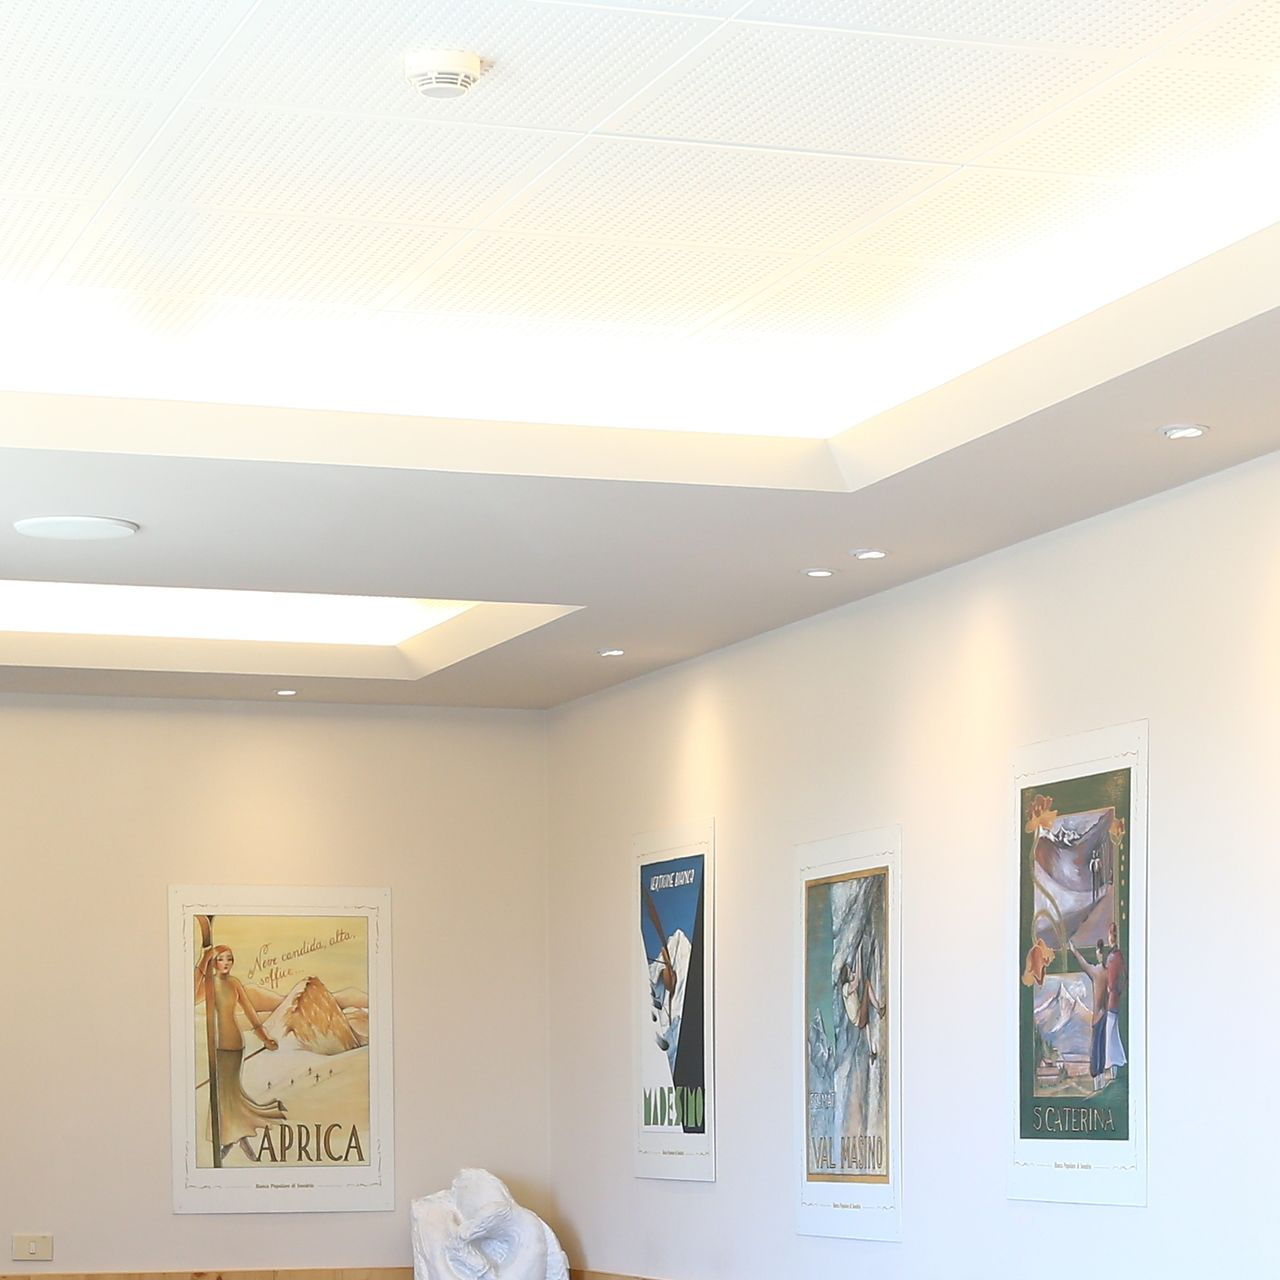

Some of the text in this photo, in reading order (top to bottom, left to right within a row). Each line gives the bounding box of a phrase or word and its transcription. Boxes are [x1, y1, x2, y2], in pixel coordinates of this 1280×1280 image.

[248, 942, 278, 979] Neve
[643, 1086, 704, 1128] MADESIMO
[257, 1124, 365, 1163] APRICA
[811, 1136, 883, 1170] VAL MASINO
